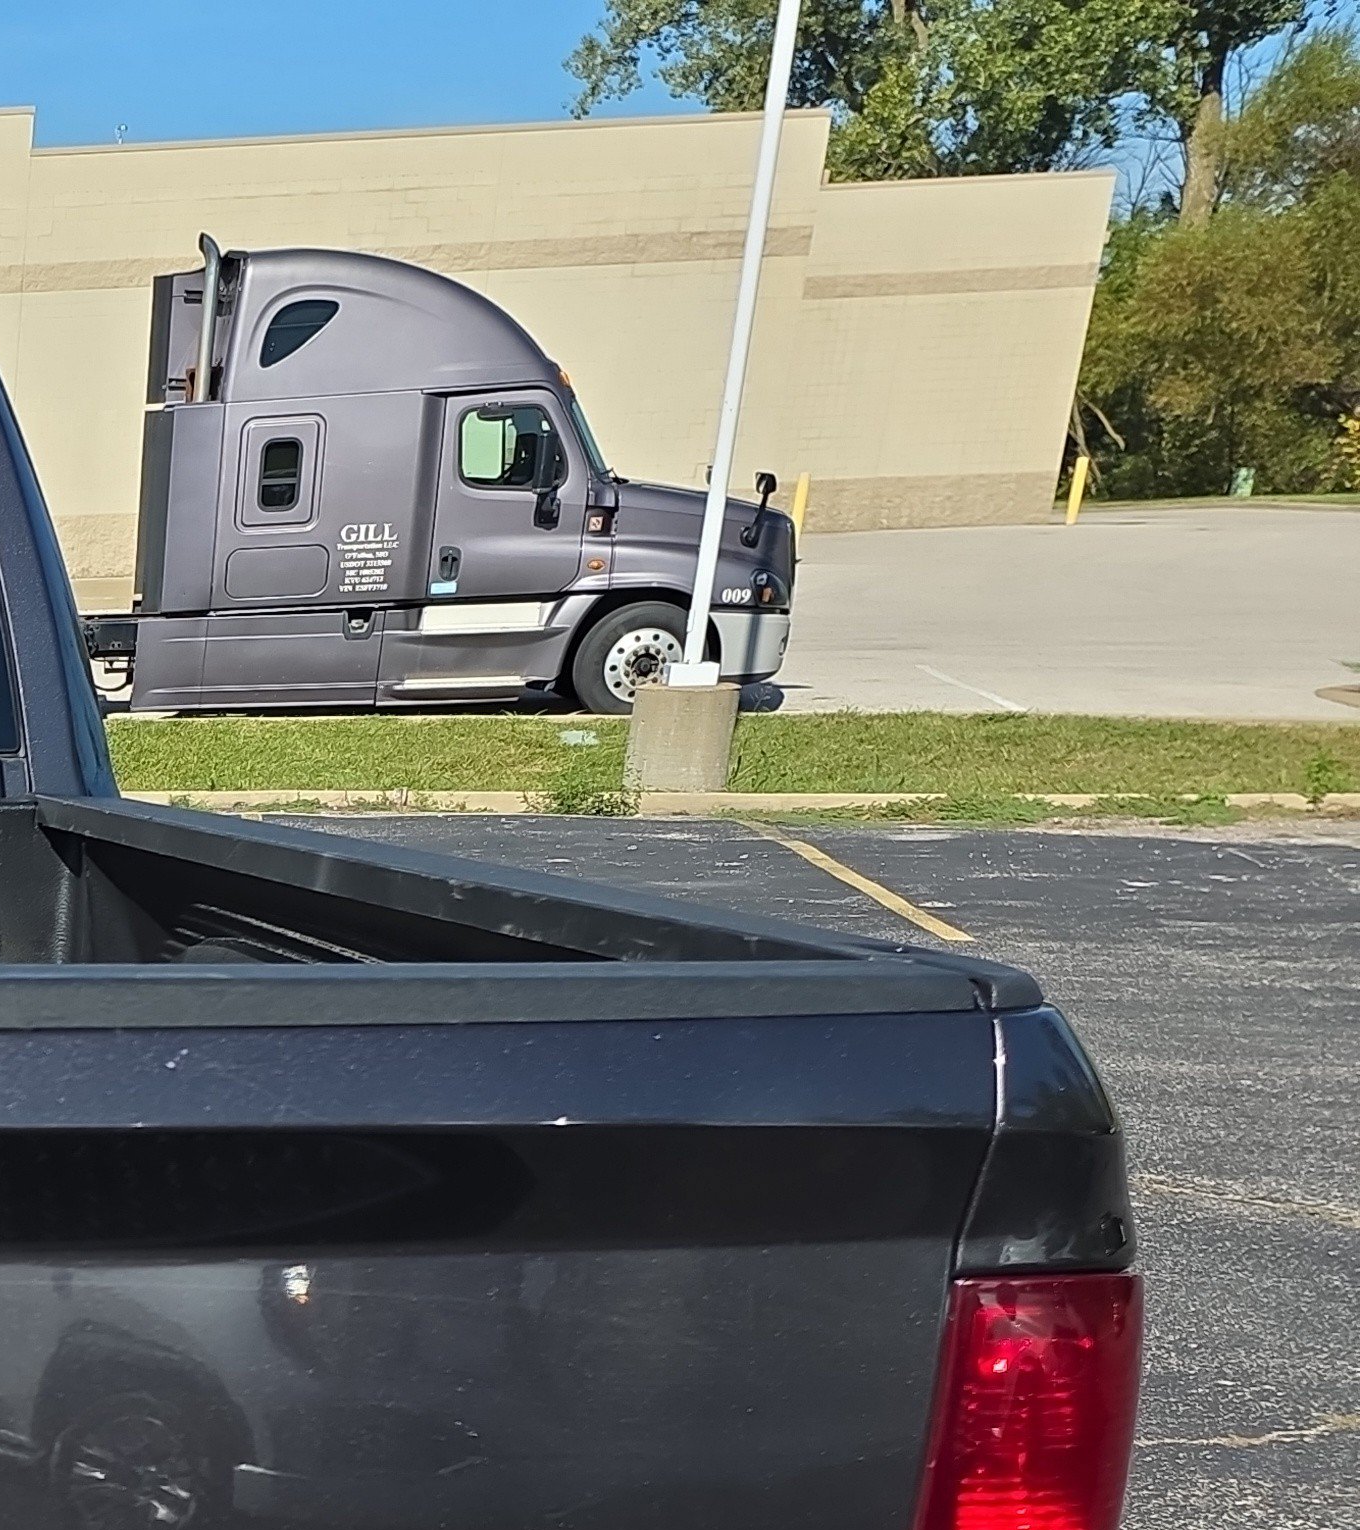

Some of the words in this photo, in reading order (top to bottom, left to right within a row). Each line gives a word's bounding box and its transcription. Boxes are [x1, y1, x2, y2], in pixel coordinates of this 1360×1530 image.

[340, 523, 398, 542] GILL
[383, 541, 399, 549] LLC
[340, 560, 365, 568] USDOT
[722, 588, 752, 604] 009
